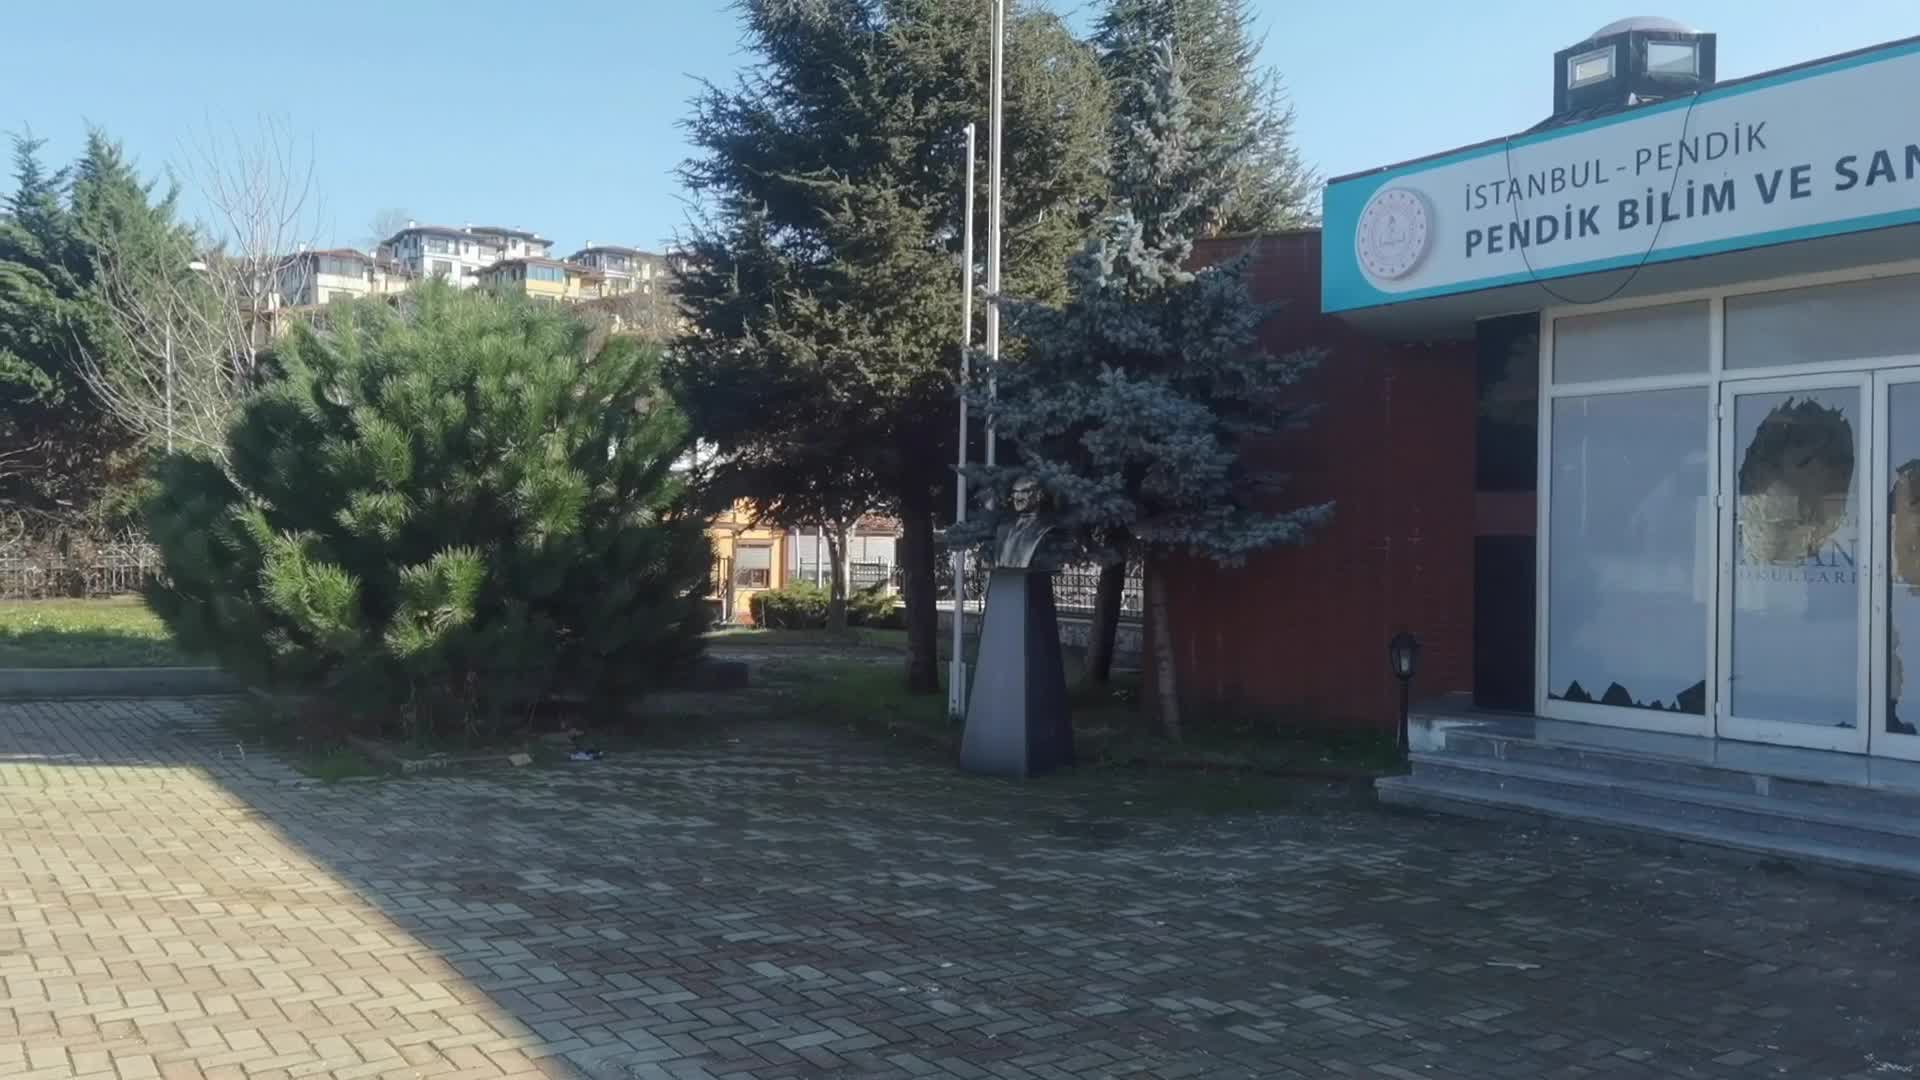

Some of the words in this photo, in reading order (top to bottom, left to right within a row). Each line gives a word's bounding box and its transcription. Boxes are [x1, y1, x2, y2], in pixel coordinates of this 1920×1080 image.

[1465, 203, 1601, 258] PENDİK
[1617, 178, 1736, 230] BİLİM
[1754, 163, 1812, 205] VE
